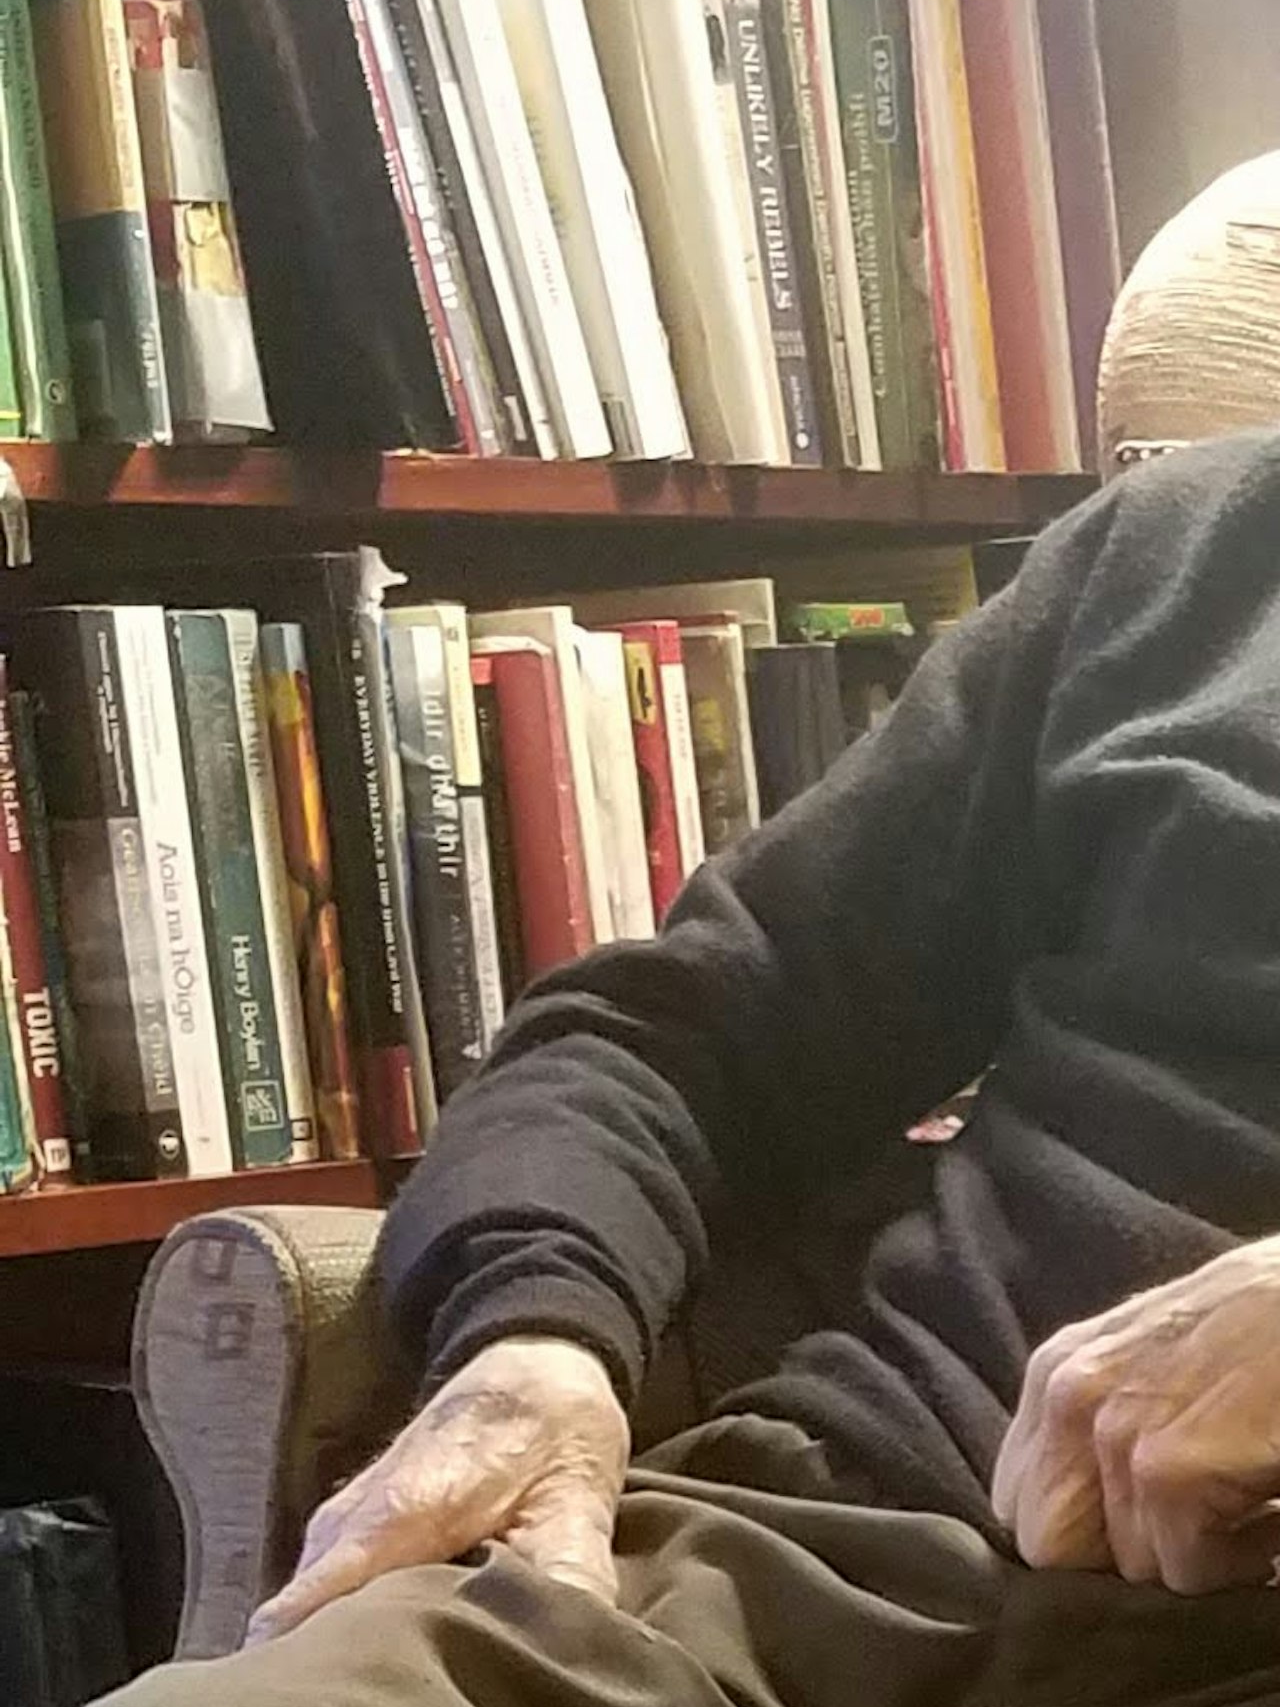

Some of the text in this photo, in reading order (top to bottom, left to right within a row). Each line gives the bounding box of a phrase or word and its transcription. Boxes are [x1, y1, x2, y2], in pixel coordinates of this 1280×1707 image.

[875, 49, 897, 129] M20
[736, 19, 795, 314] UNLIKELY REBELS
[155, 842, 203, 1036] Aois na hÓige
[230, 935, 263, 1072] Henry Boylan
[22, 988, 60, 1081] TOXIC
